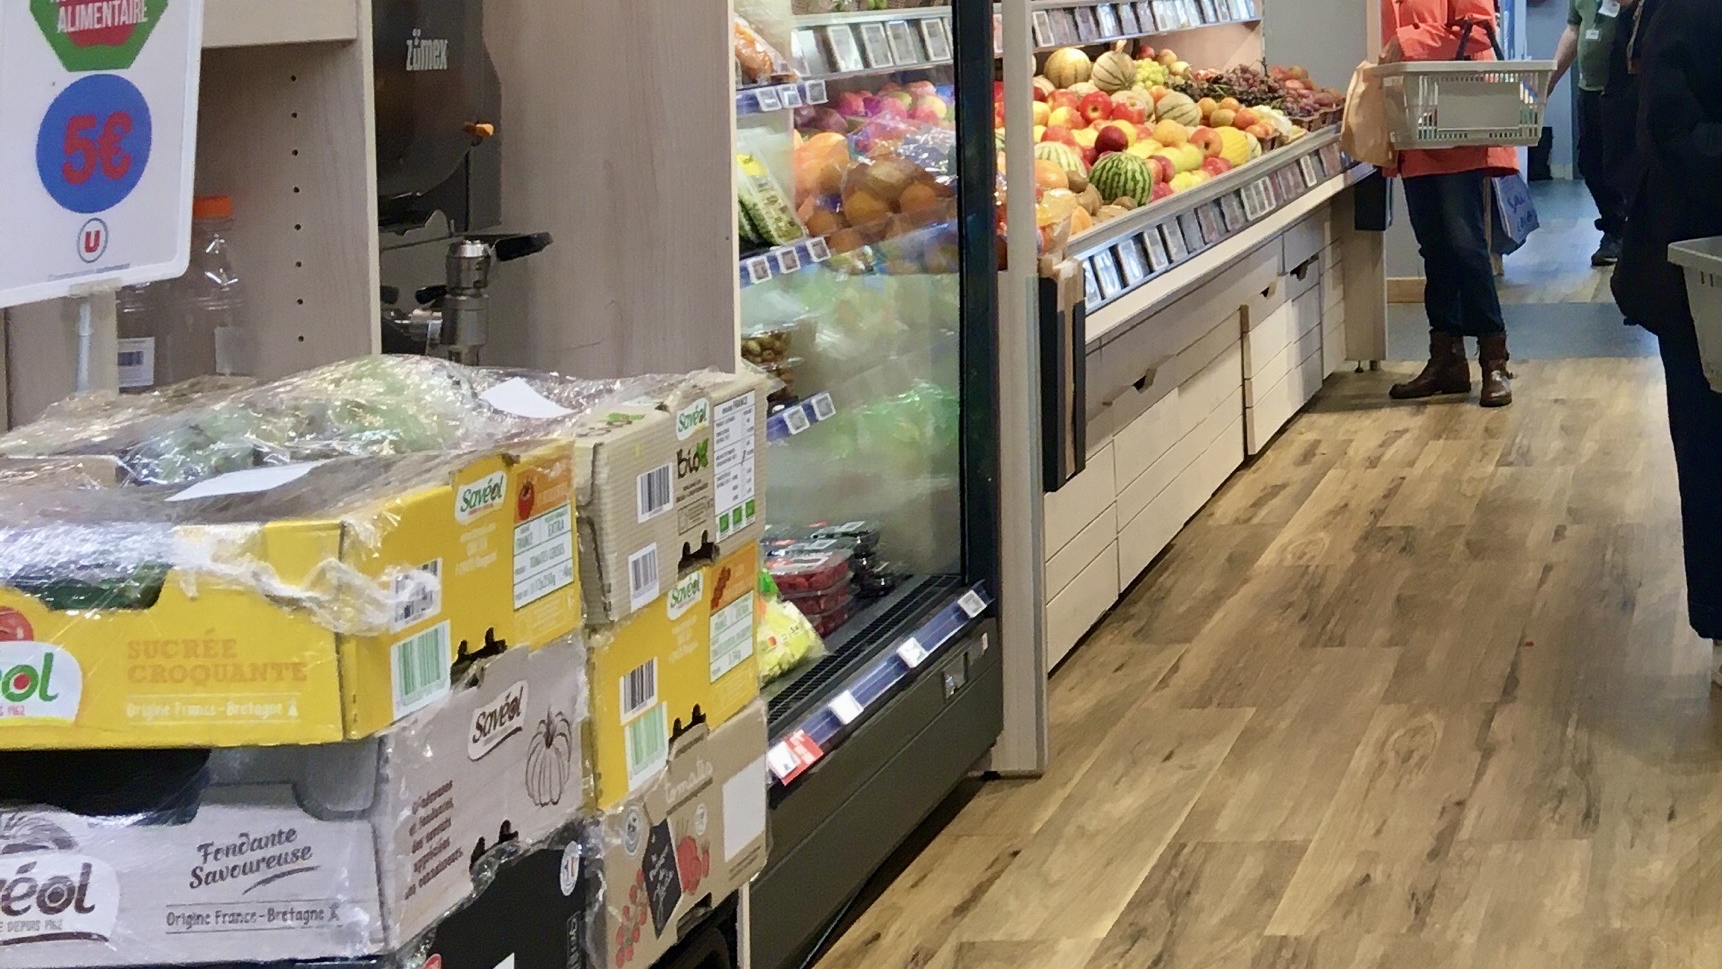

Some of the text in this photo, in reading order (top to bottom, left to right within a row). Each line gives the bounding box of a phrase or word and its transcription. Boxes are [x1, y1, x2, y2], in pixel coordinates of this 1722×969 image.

[406, 28, 448, 71] zümex
[62, 110, 133, 185] 5€
[84, 230, 100, 253] U
[676, 448, 700, 479] bio
[460, 475, 504, 513] Savéol
[127, 629, 238, 660] SUCRÉE
[127, 662, 309, 687] CROQUANTE
[472, 685, 524, 744] Savéol
[197, 828, 298, 865] Fondante
[189, 845, 313, 889] Savoureuse
[0, 861, 95, 917] éol
[166, 911, 211, 930] Origine
